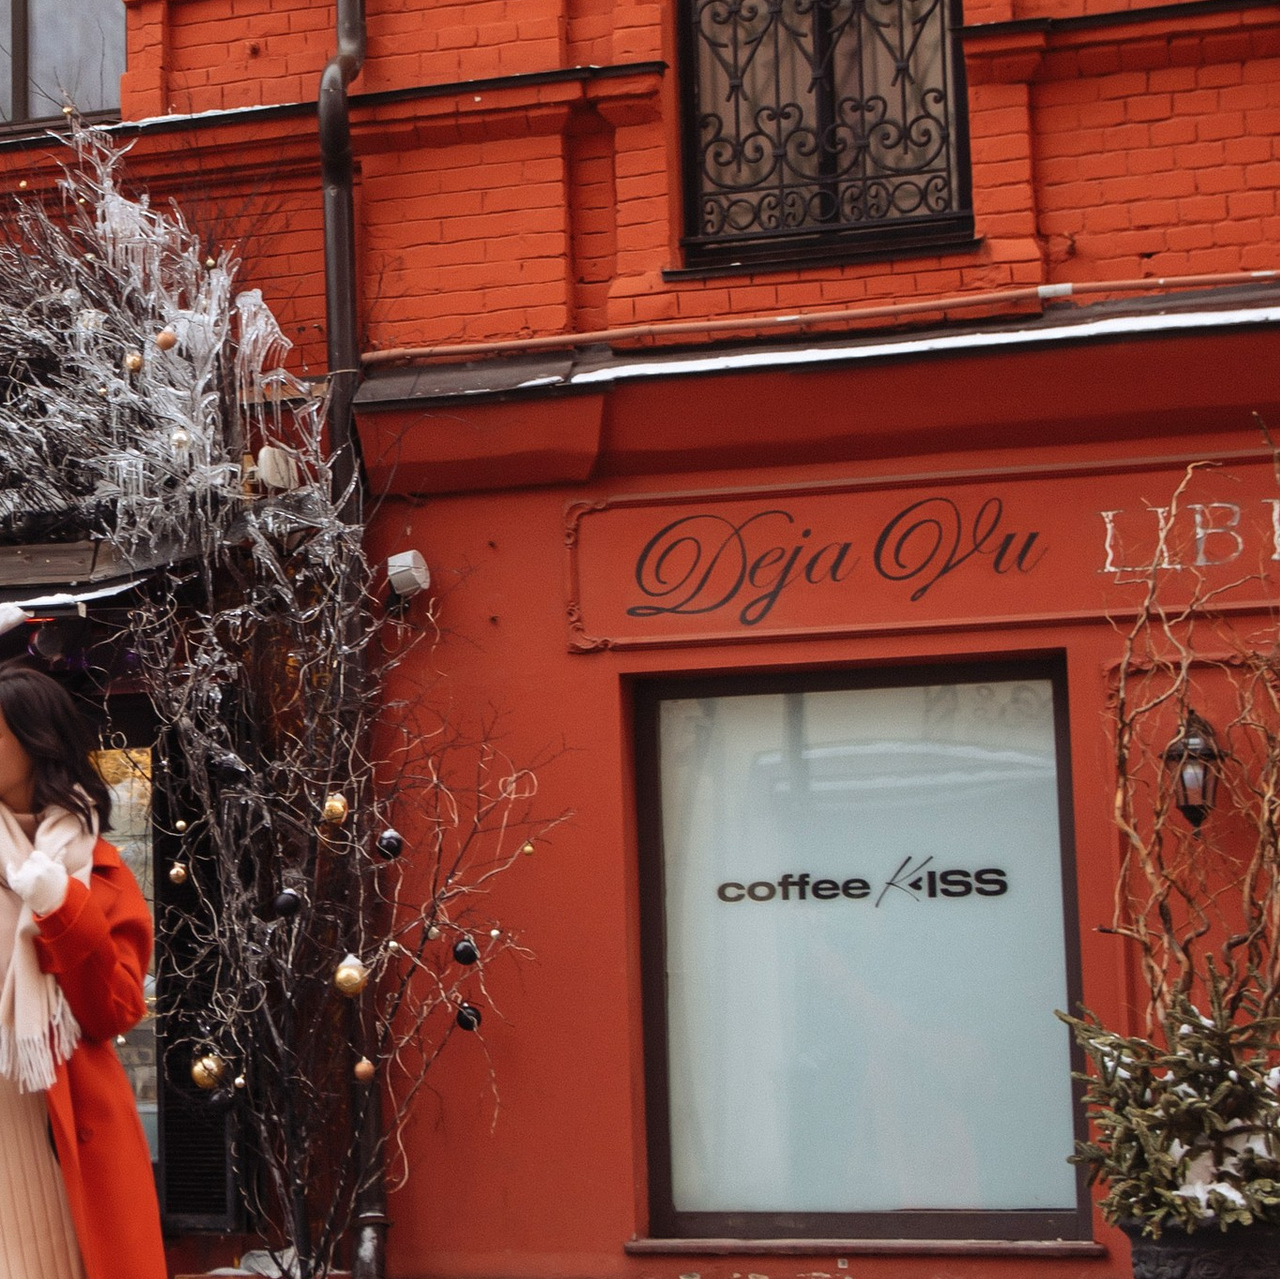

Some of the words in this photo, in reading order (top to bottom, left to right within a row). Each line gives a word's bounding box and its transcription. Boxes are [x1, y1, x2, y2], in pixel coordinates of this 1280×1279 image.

[626, 510, 860, 626] Deja
[873, 497, 1048, 602] Vu
[717, 873, 871, 903] coffee
[875, 855, 1008, 909] KISS
